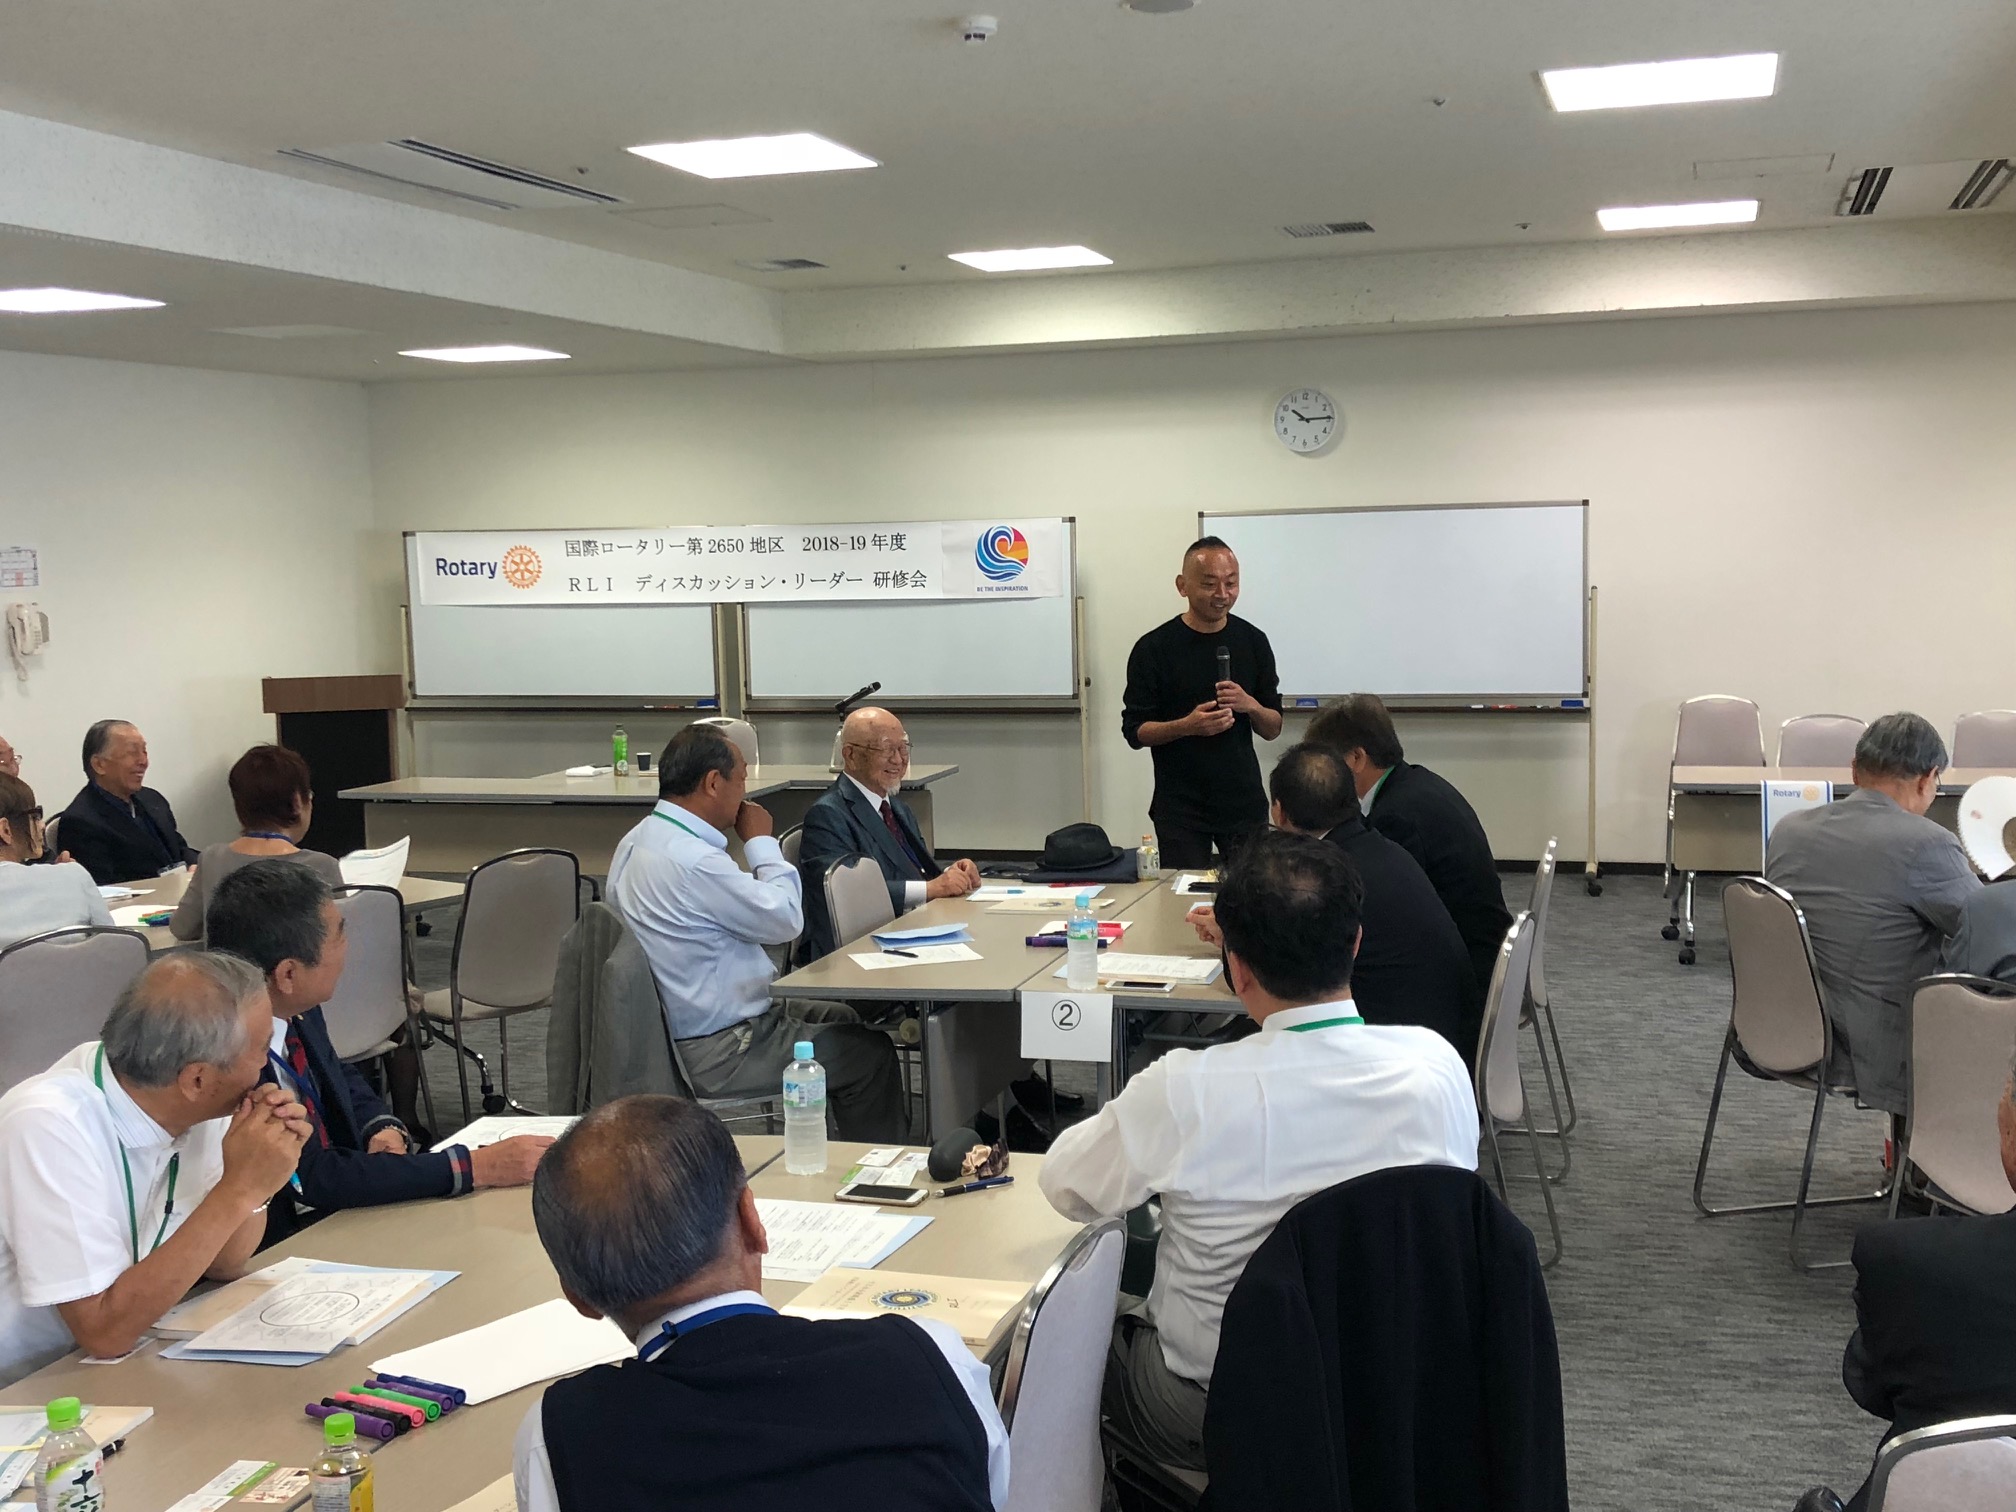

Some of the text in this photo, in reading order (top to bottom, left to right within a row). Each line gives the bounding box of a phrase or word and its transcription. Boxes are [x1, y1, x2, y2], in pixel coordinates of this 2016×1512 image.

[1283, 404, 1289, 412] 10
[1322, 404, 1327, 412] 2
[1303, 439, 1307, 447] 6
[1314, 435, 1318, 443] 5
[435, 557, 498, 579] Rotary
[872, 569, 928, 589] 研修会
[1773, 789, 1801, 798] Rotary
